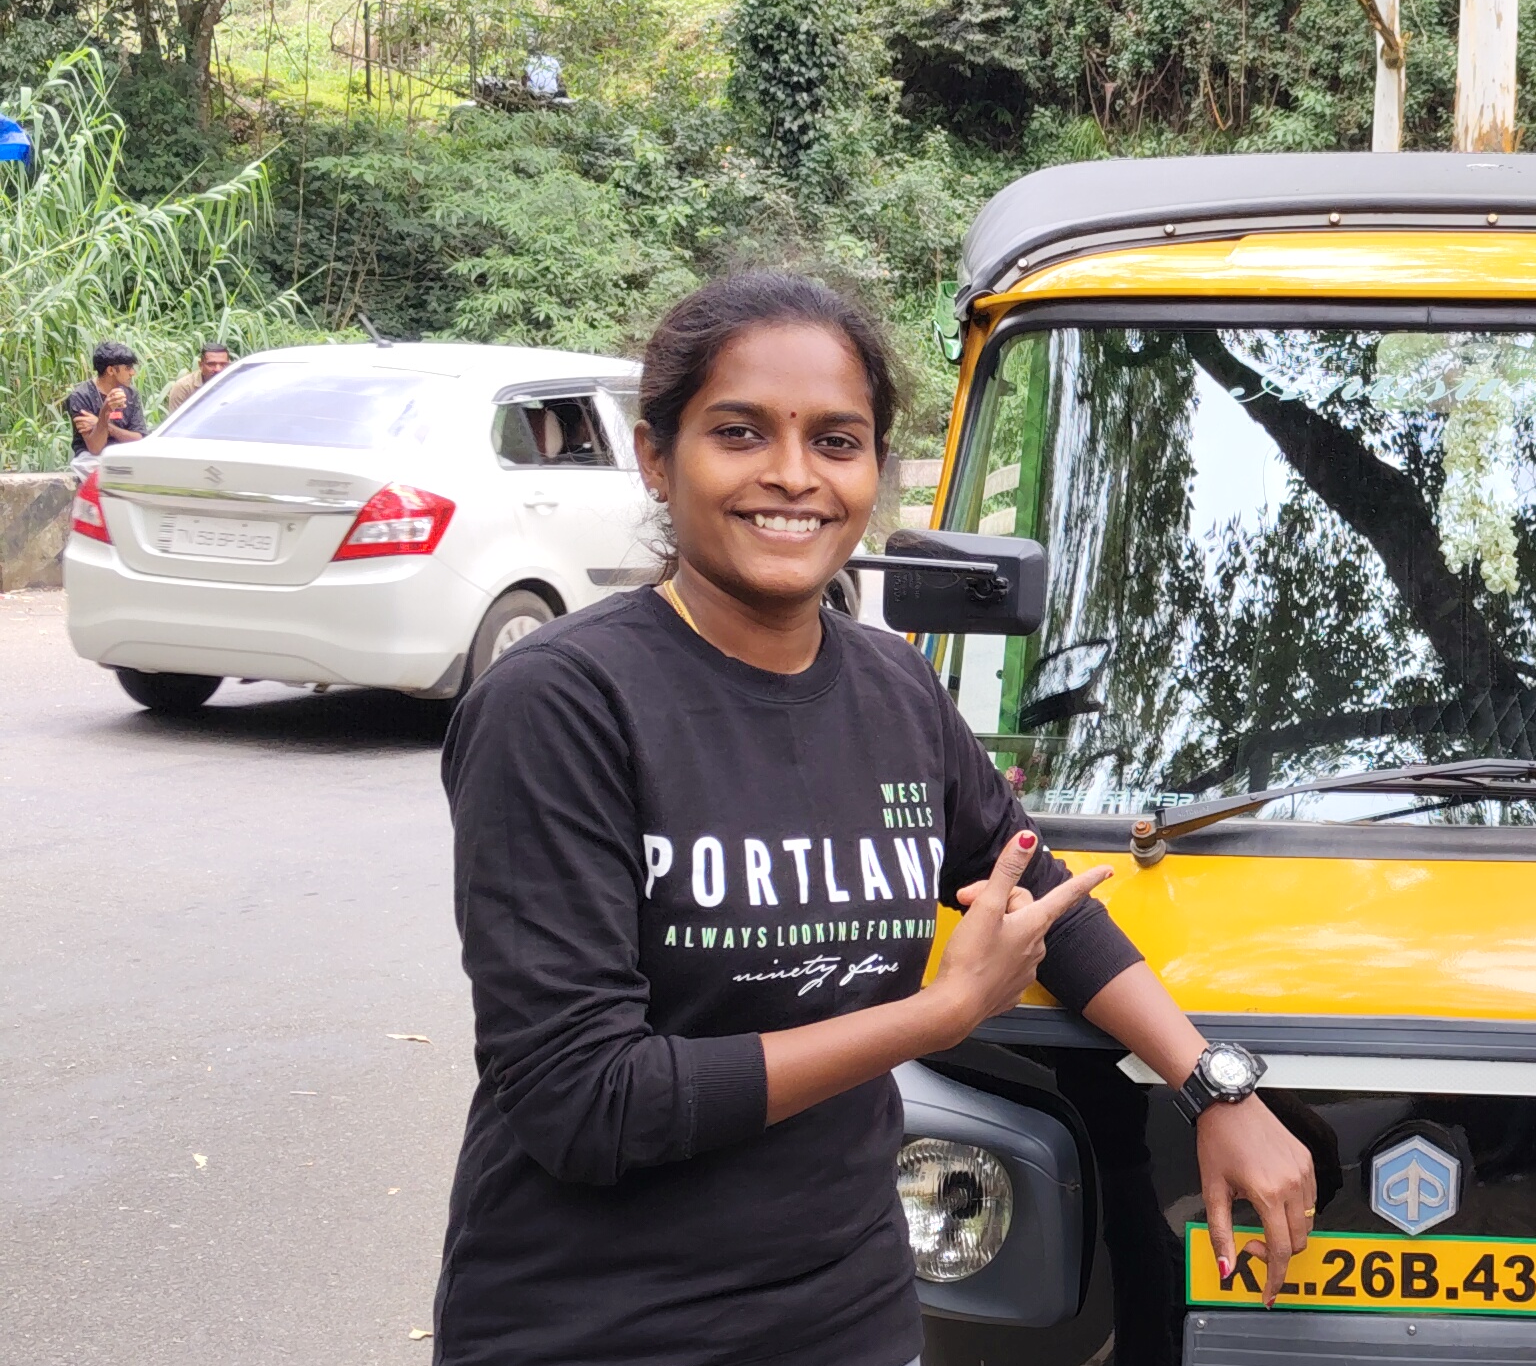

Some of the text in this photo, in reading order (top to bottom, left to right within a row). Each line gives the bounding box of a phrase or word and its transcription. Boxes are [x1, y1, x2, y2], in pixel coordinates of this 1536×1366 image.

[880, 782, 928, 804] WEST
[882, 807, 934, 829] HILLS
[664, 924, 768, 949] ALWAYS
[777, 922, 859, 947] LOOKING
[732, 953, 900, 996] ninety five
